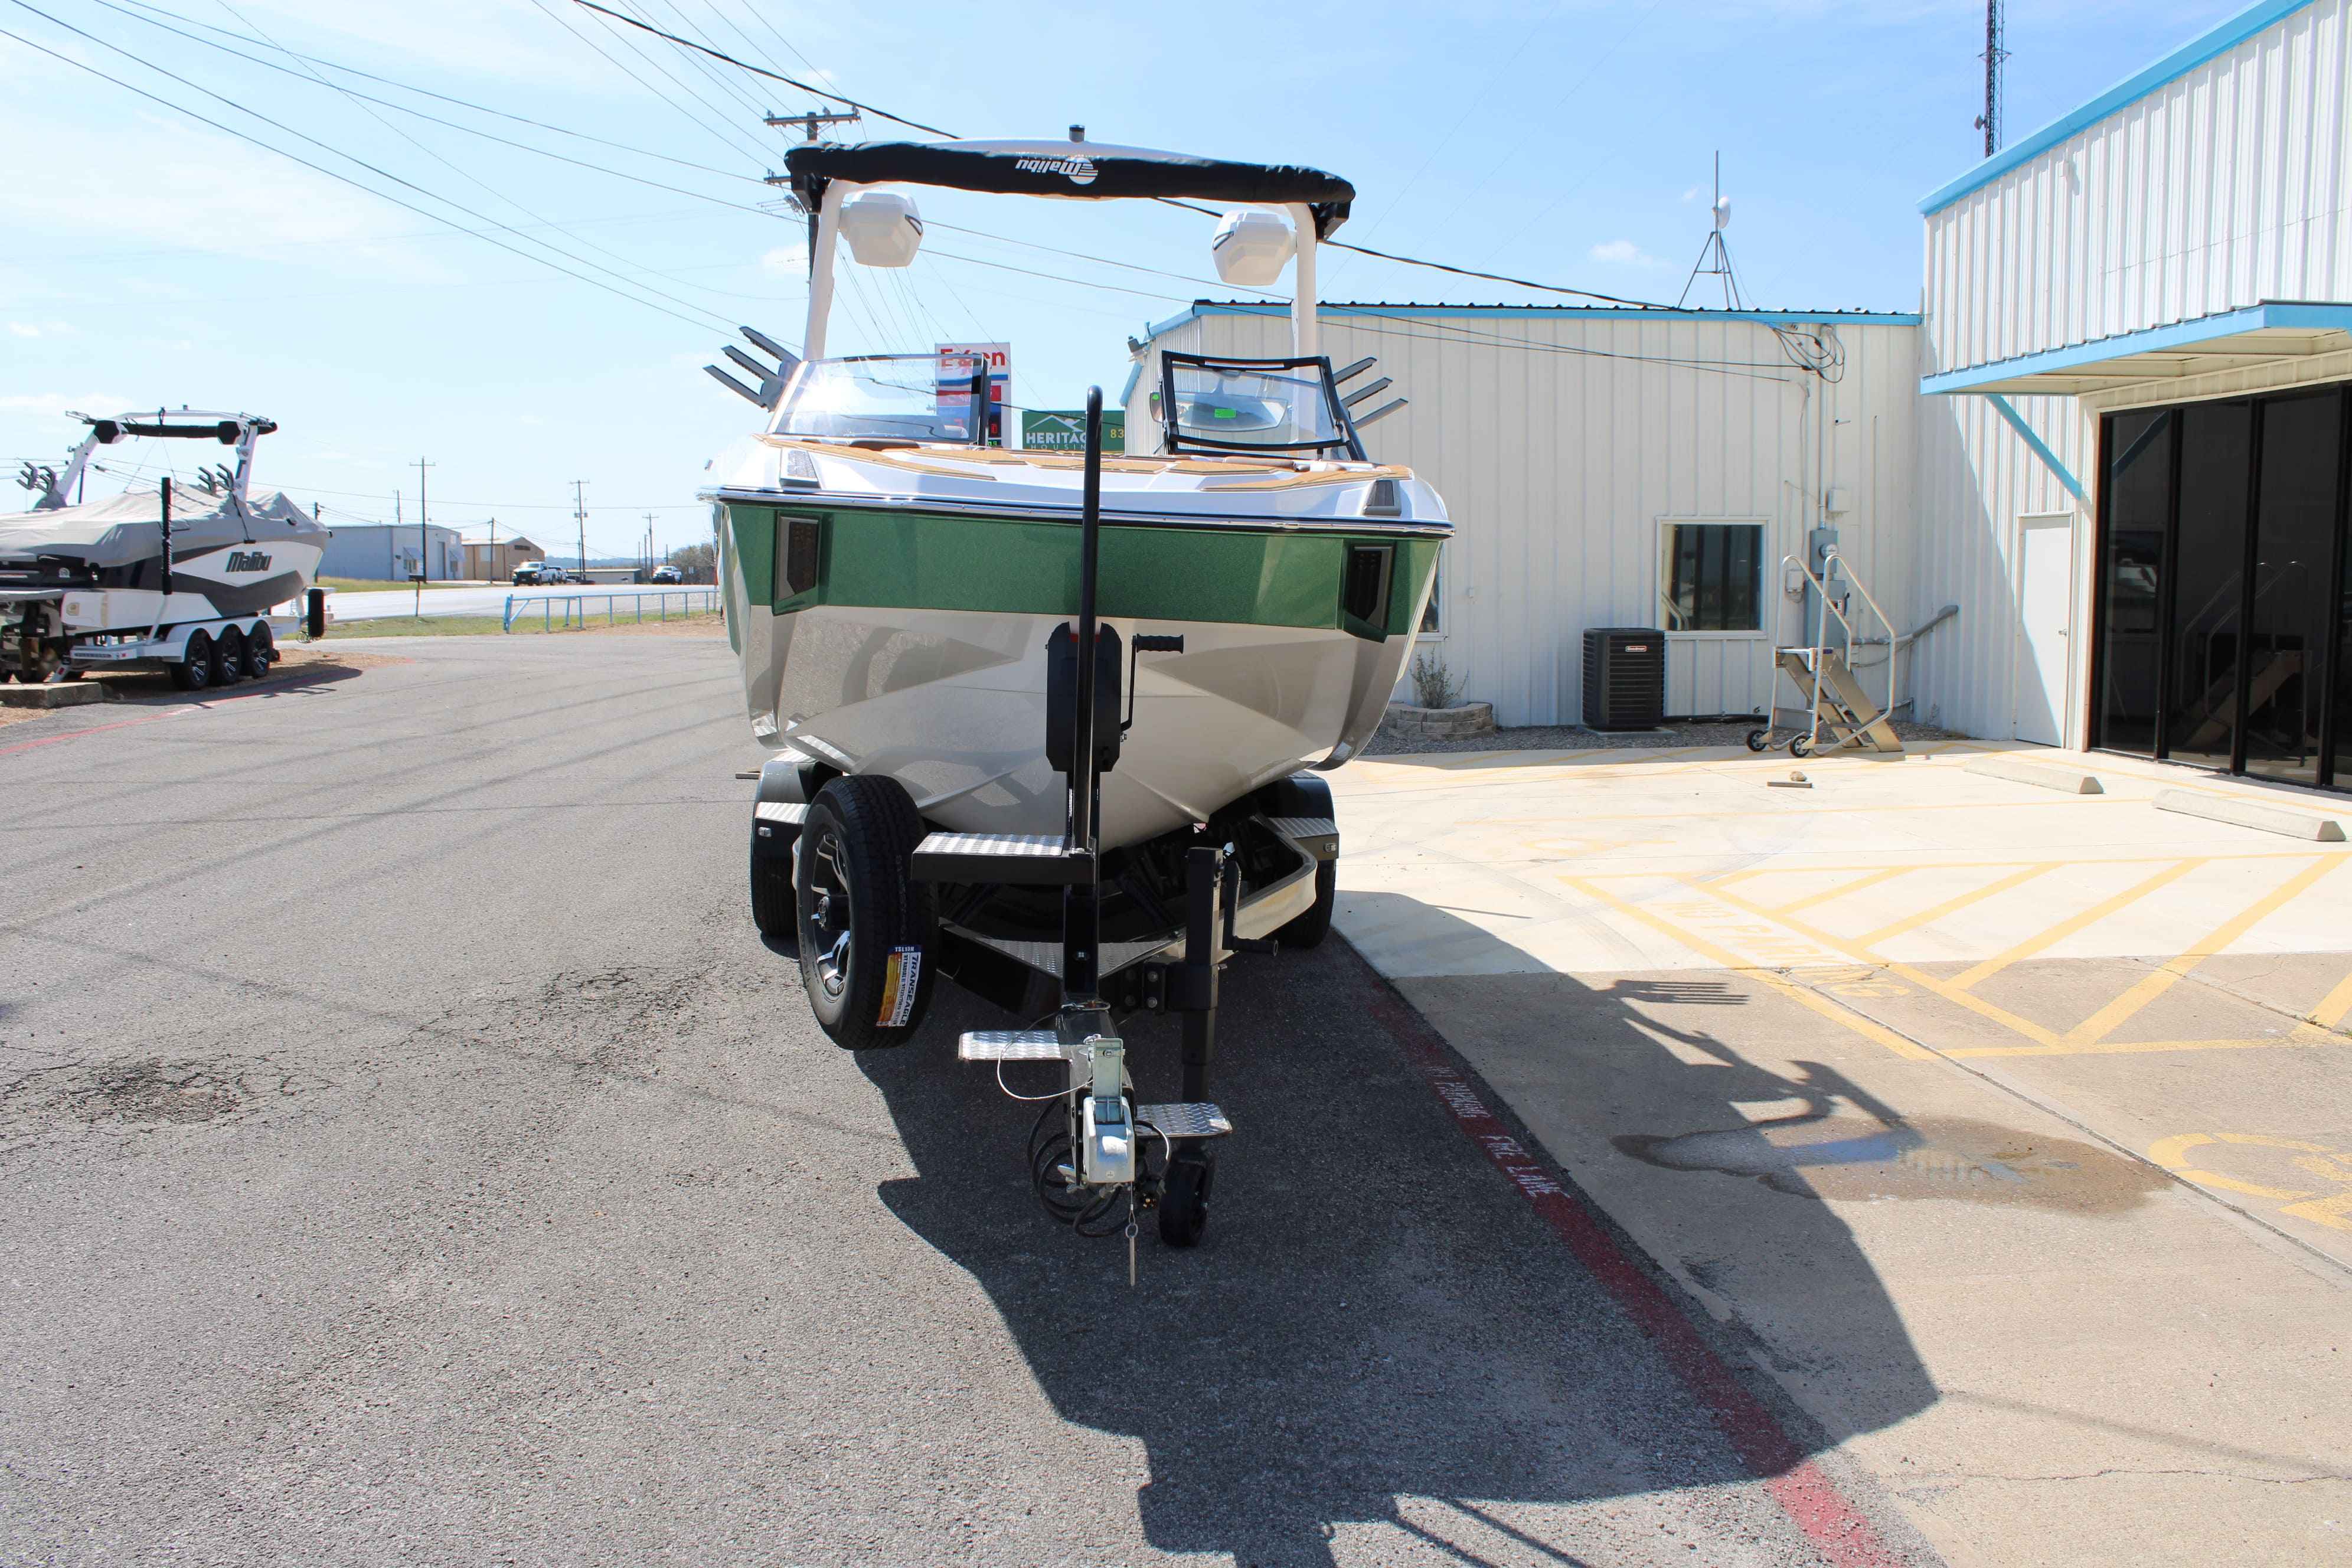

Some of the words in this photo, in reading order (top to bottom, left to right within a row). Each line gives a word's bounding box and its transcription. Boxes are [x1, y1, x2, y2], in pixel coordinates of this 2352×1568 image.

[1015, 159, 1082, 176] Malibu
[226, 551, 272, 573] Malibu
[900, 955, 919, 1025] TRANSEAGLE
